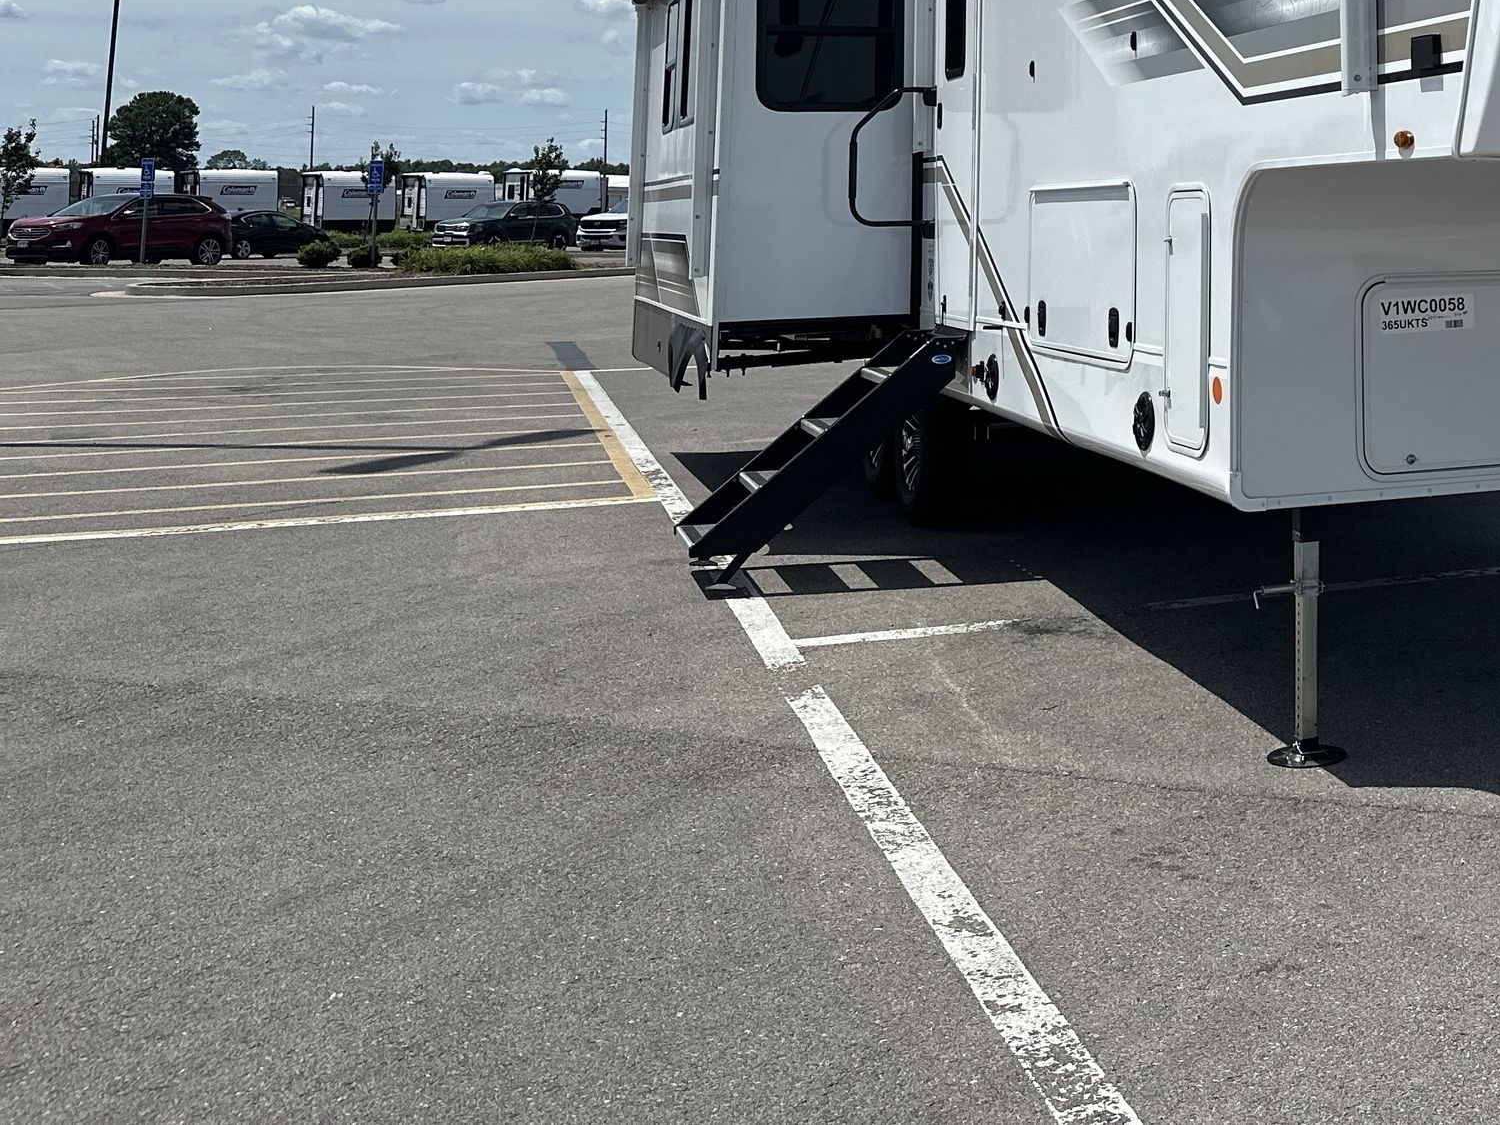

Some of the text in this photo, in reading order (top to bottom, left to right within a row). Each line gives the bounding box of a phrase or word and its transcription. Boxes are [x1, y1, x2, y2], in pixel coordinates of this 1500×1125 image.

[222, 185, 250, 194] Coleman
[1380, 296, 1466, 316] V1WC0058
[1381, 317, 1428, 331] 365UKTS
